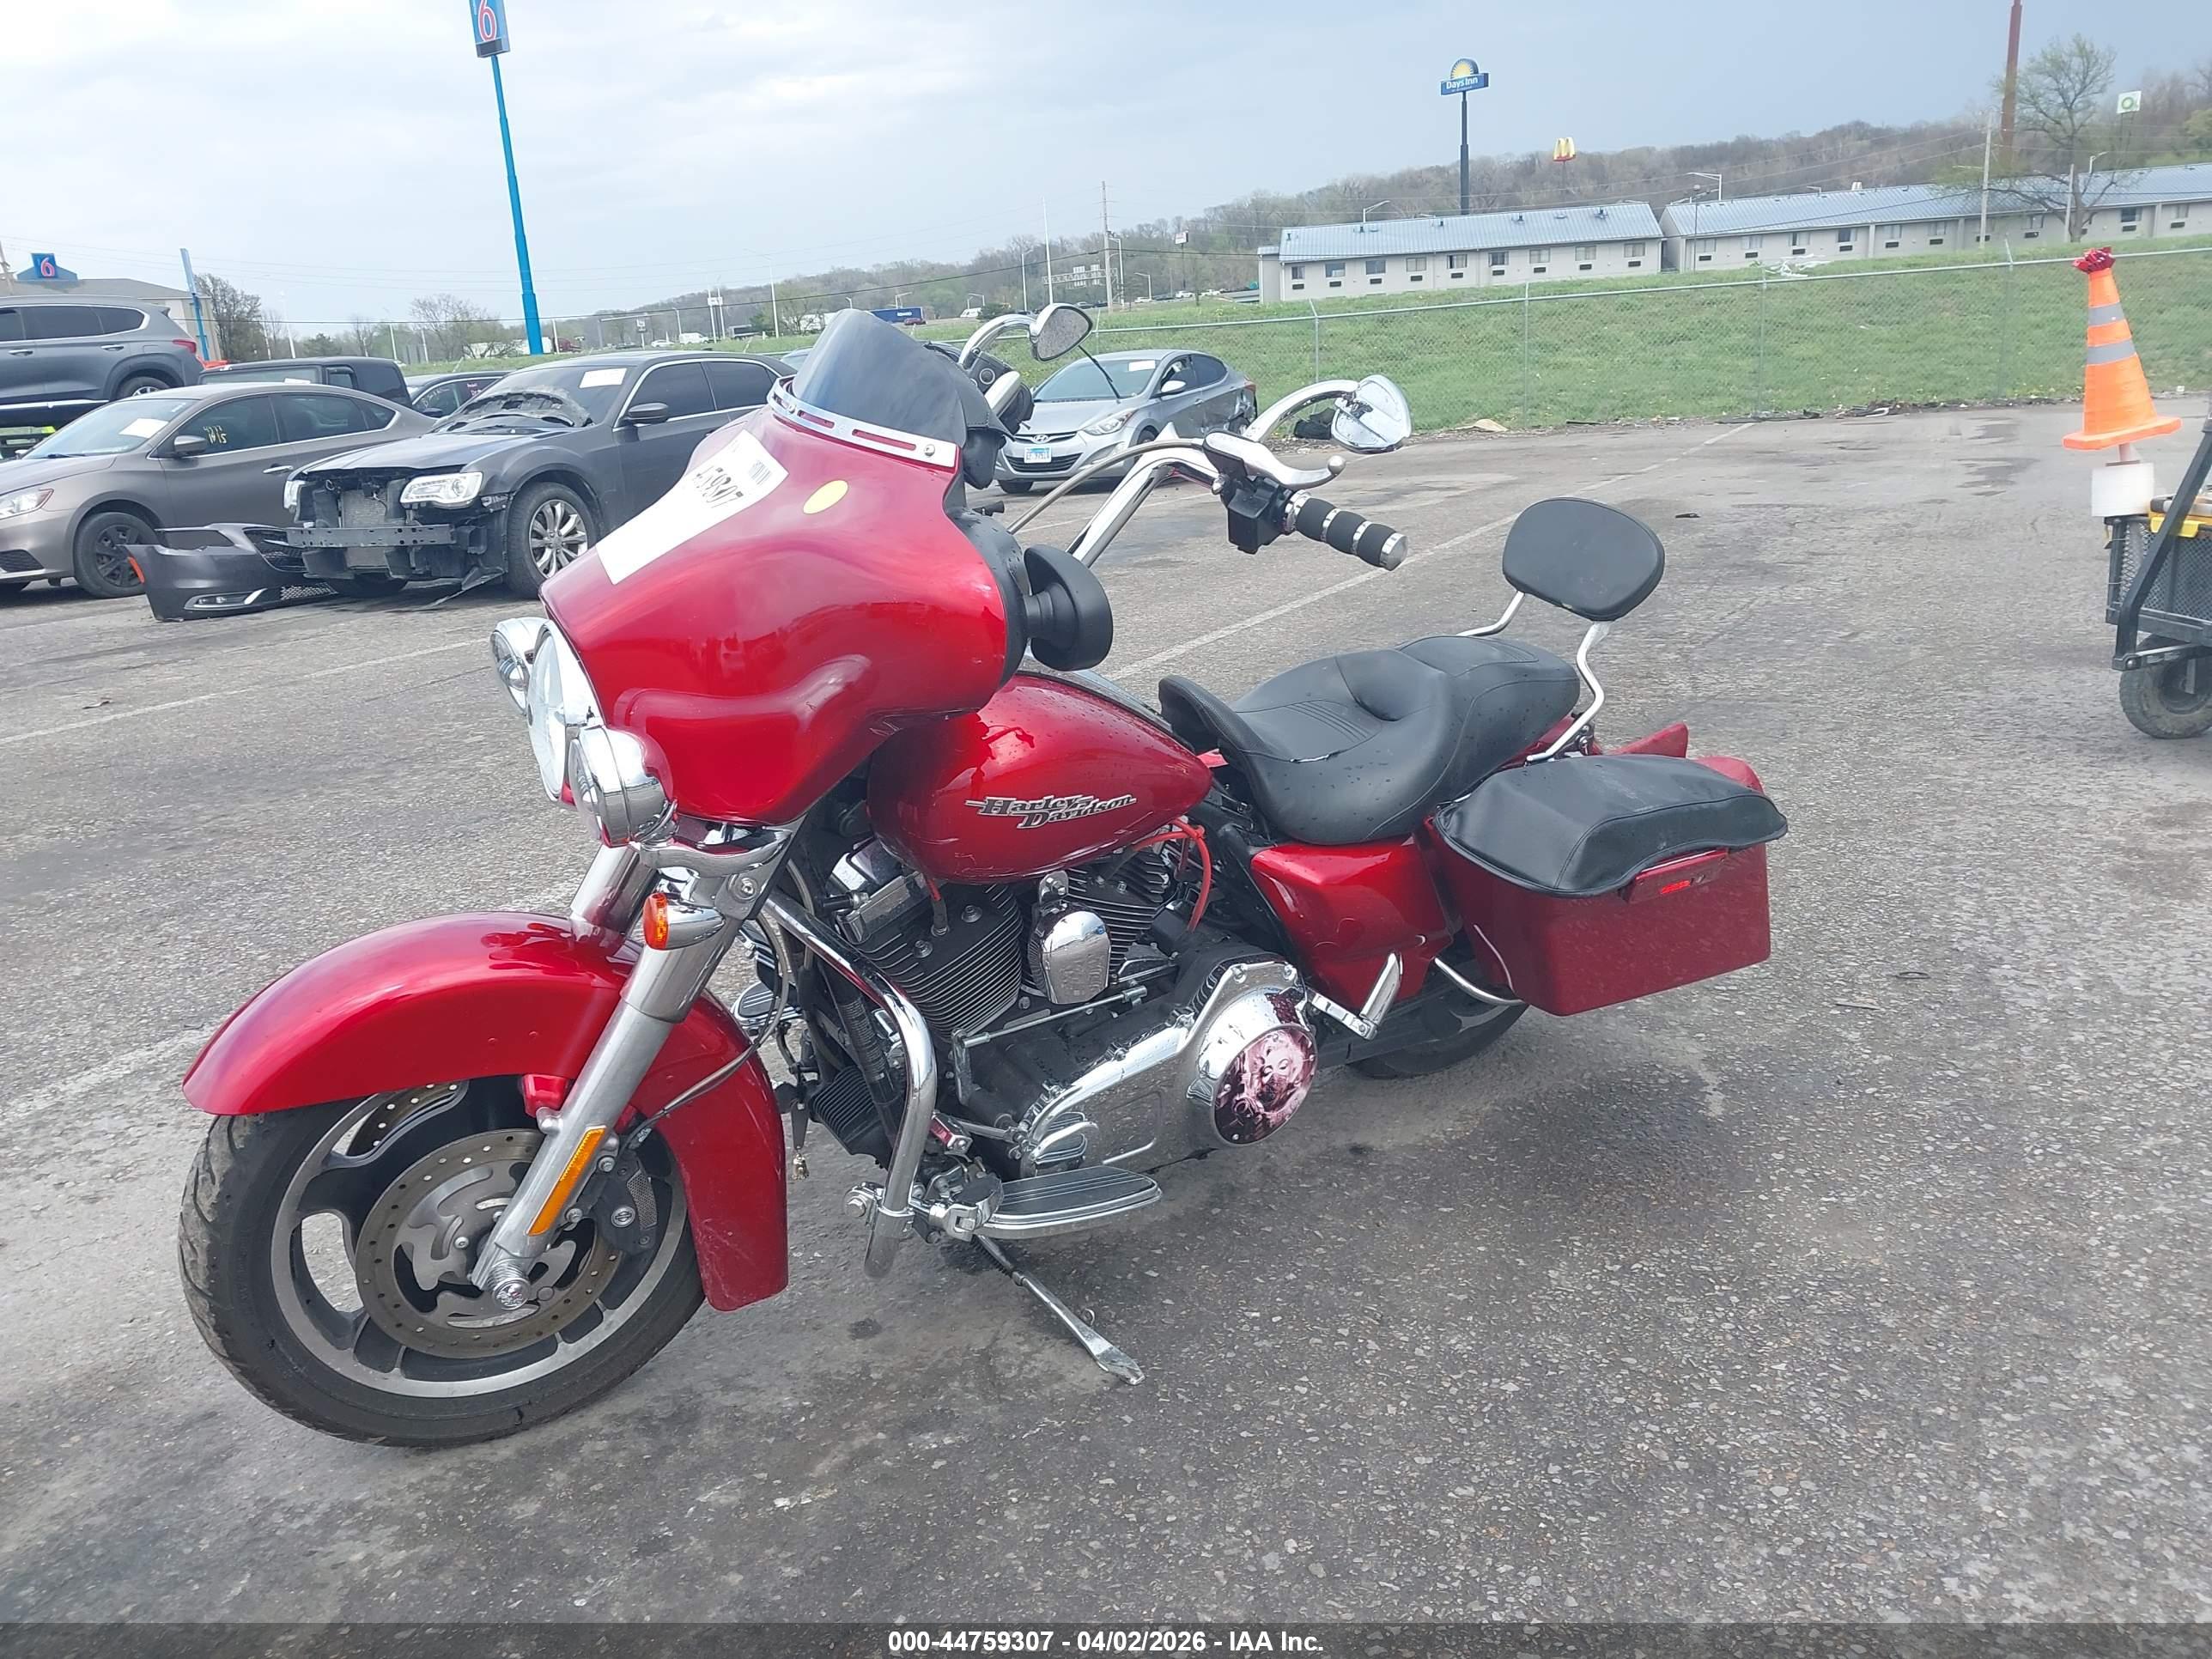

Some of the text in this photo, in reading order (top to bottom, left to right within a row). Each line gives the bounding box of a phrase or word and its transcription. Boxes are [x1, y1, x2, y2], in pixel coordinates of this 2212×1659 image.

[478, 0, 497, 42] 6
[1446, 80, 1465, 89] Days
[1465, 77, 1478, 86] Inn
[40, 257, 55, 277] 6
[965, 795, 1093, 817] Harley
[1016, 794, 1137, 829] Davidson
